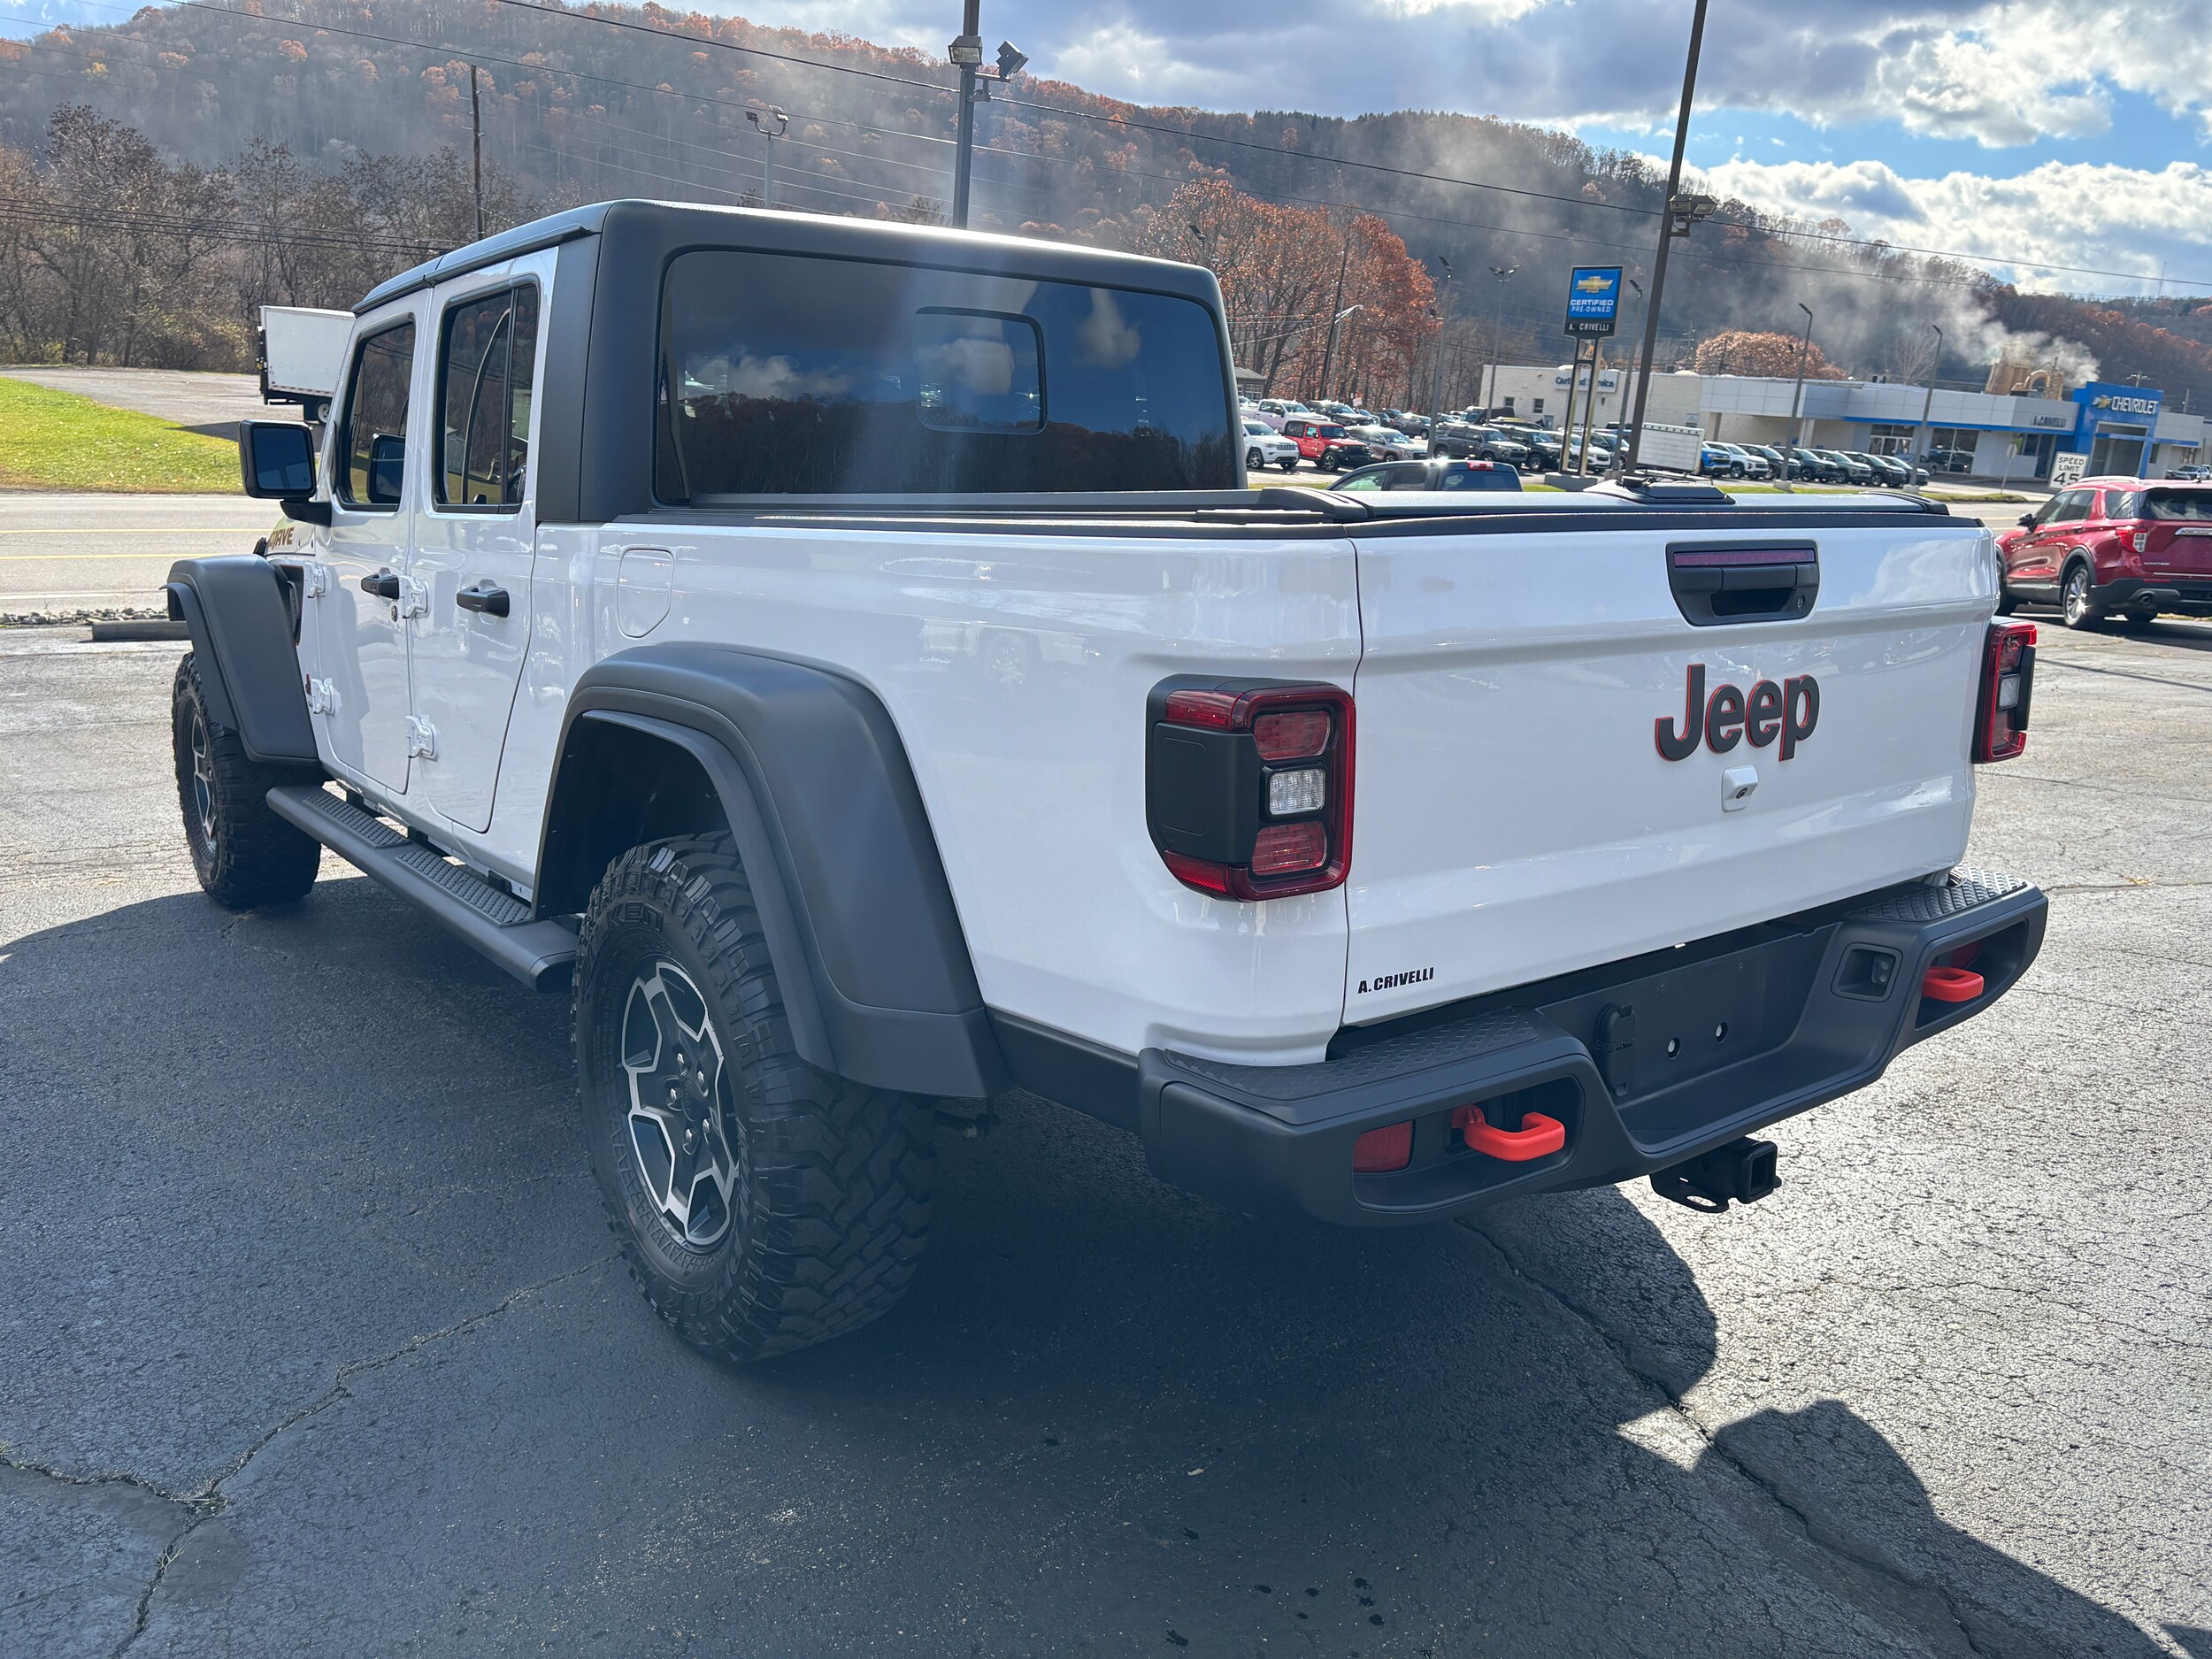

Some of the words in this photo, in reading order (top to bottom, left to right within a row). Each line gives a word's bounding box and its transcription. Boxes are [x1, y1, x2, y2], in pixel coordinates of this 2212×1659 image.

[1579, 322, 1609, 332] CRIVELLI
[2111, 396, 2159, 415] CHEVROLET
[2058, 457, 2085, 465] SPEED
[2053, 472, 2080, 485] 45
[269, 526, 296, 549] OJAVE
[1655, 664, 1820, 762] Jeep
